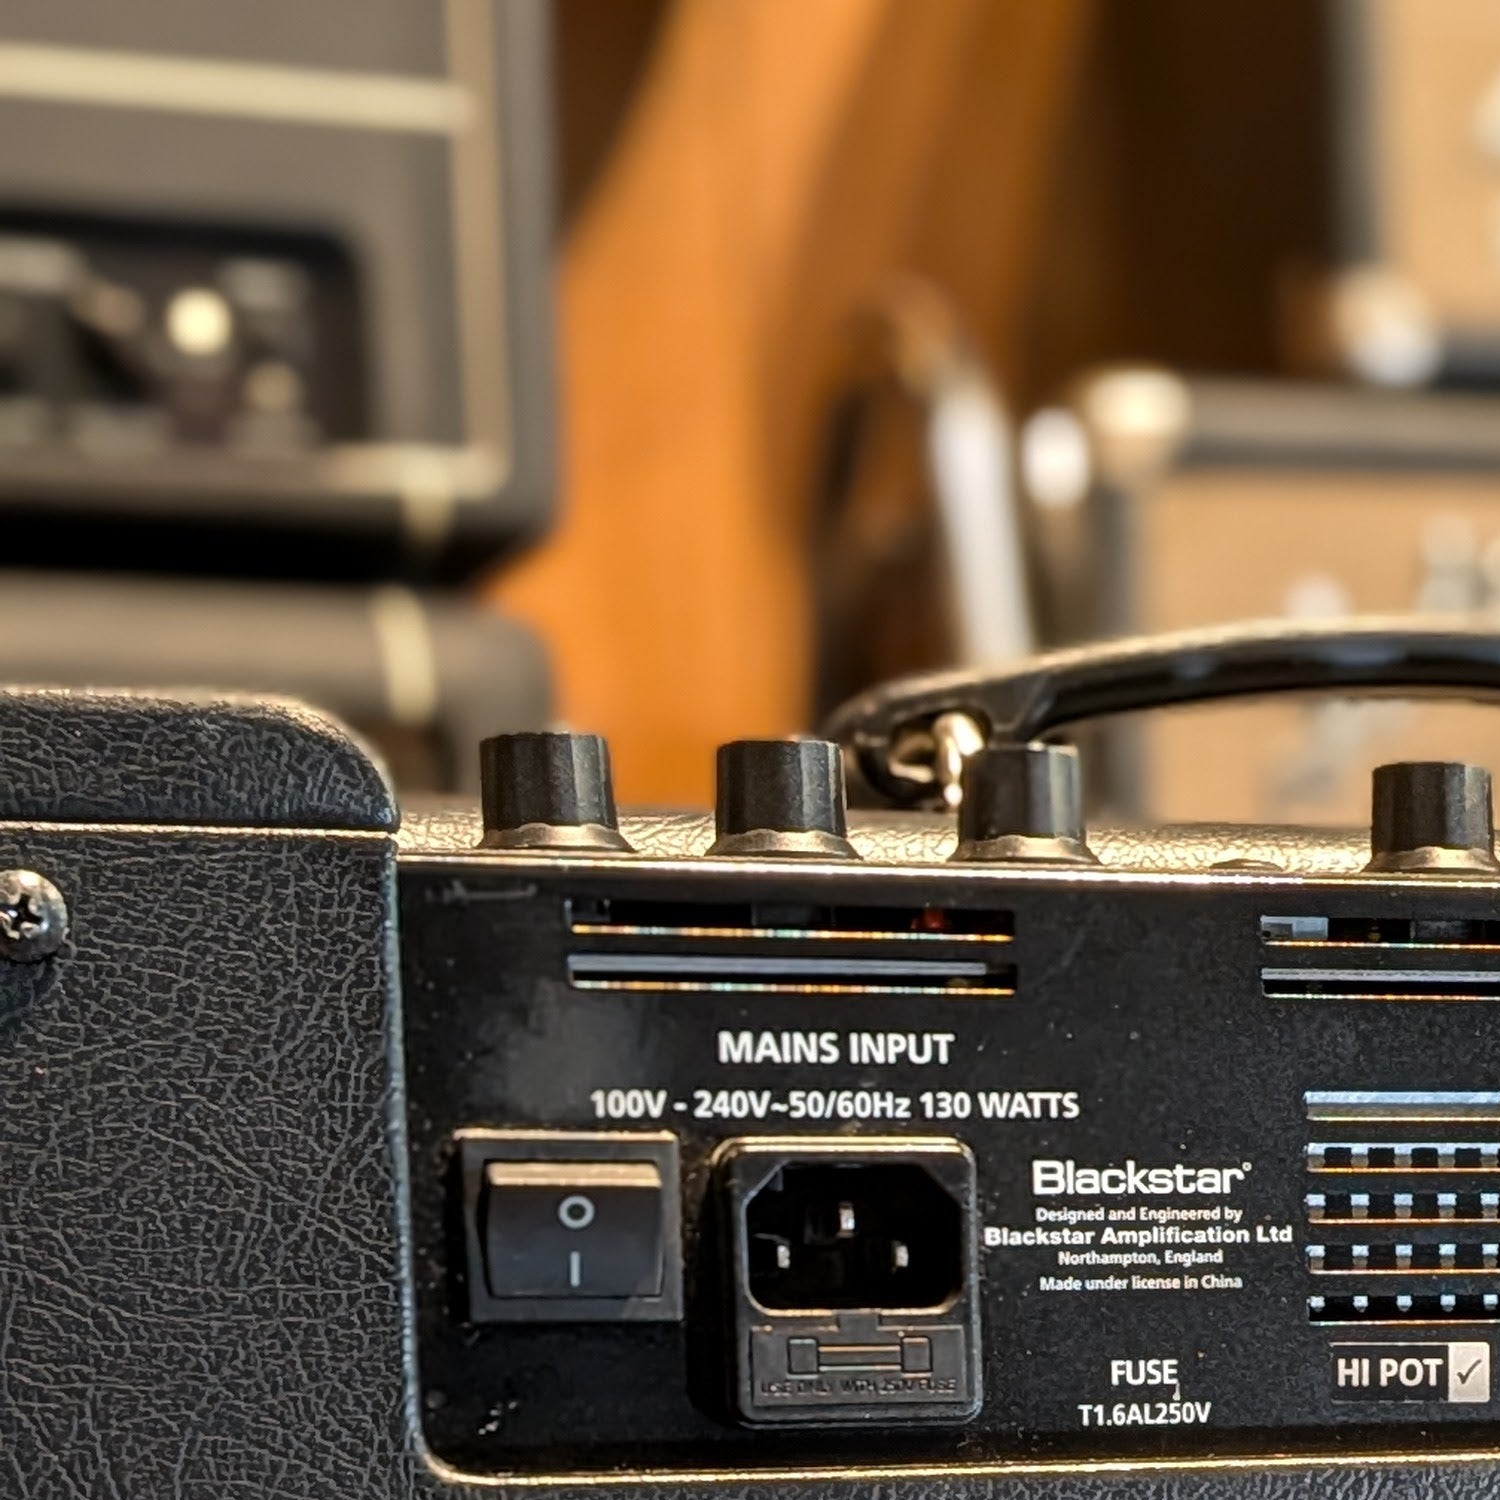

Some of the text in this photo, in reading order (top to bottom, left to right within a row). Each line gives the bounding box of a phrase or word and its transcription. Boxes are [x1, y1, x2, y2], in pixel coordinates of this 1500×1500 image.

[719, 1032, 954, 1064] MAINS INPUT
[591, 1090, 666, 1117] 100V
[920, 1092, 971, 1118] 130
[978, 1092, 1079, 1118] WATTS
[1036, 1206, 1242, 1224] Designed and Engineered by
[984, 1225, 1292, 1247] Blackstar Amplification Ltd
[1058, 1249, 1223, 1267] Northampton, England
[1040, 1274, 1242, 1290] Made under license in China
[1111, 1359, 1179, 1389] FUSE
[1338, 1359, 1443, 1386] HI POT
[1078, 1402, 1211, 1425] T1.6AL250V
